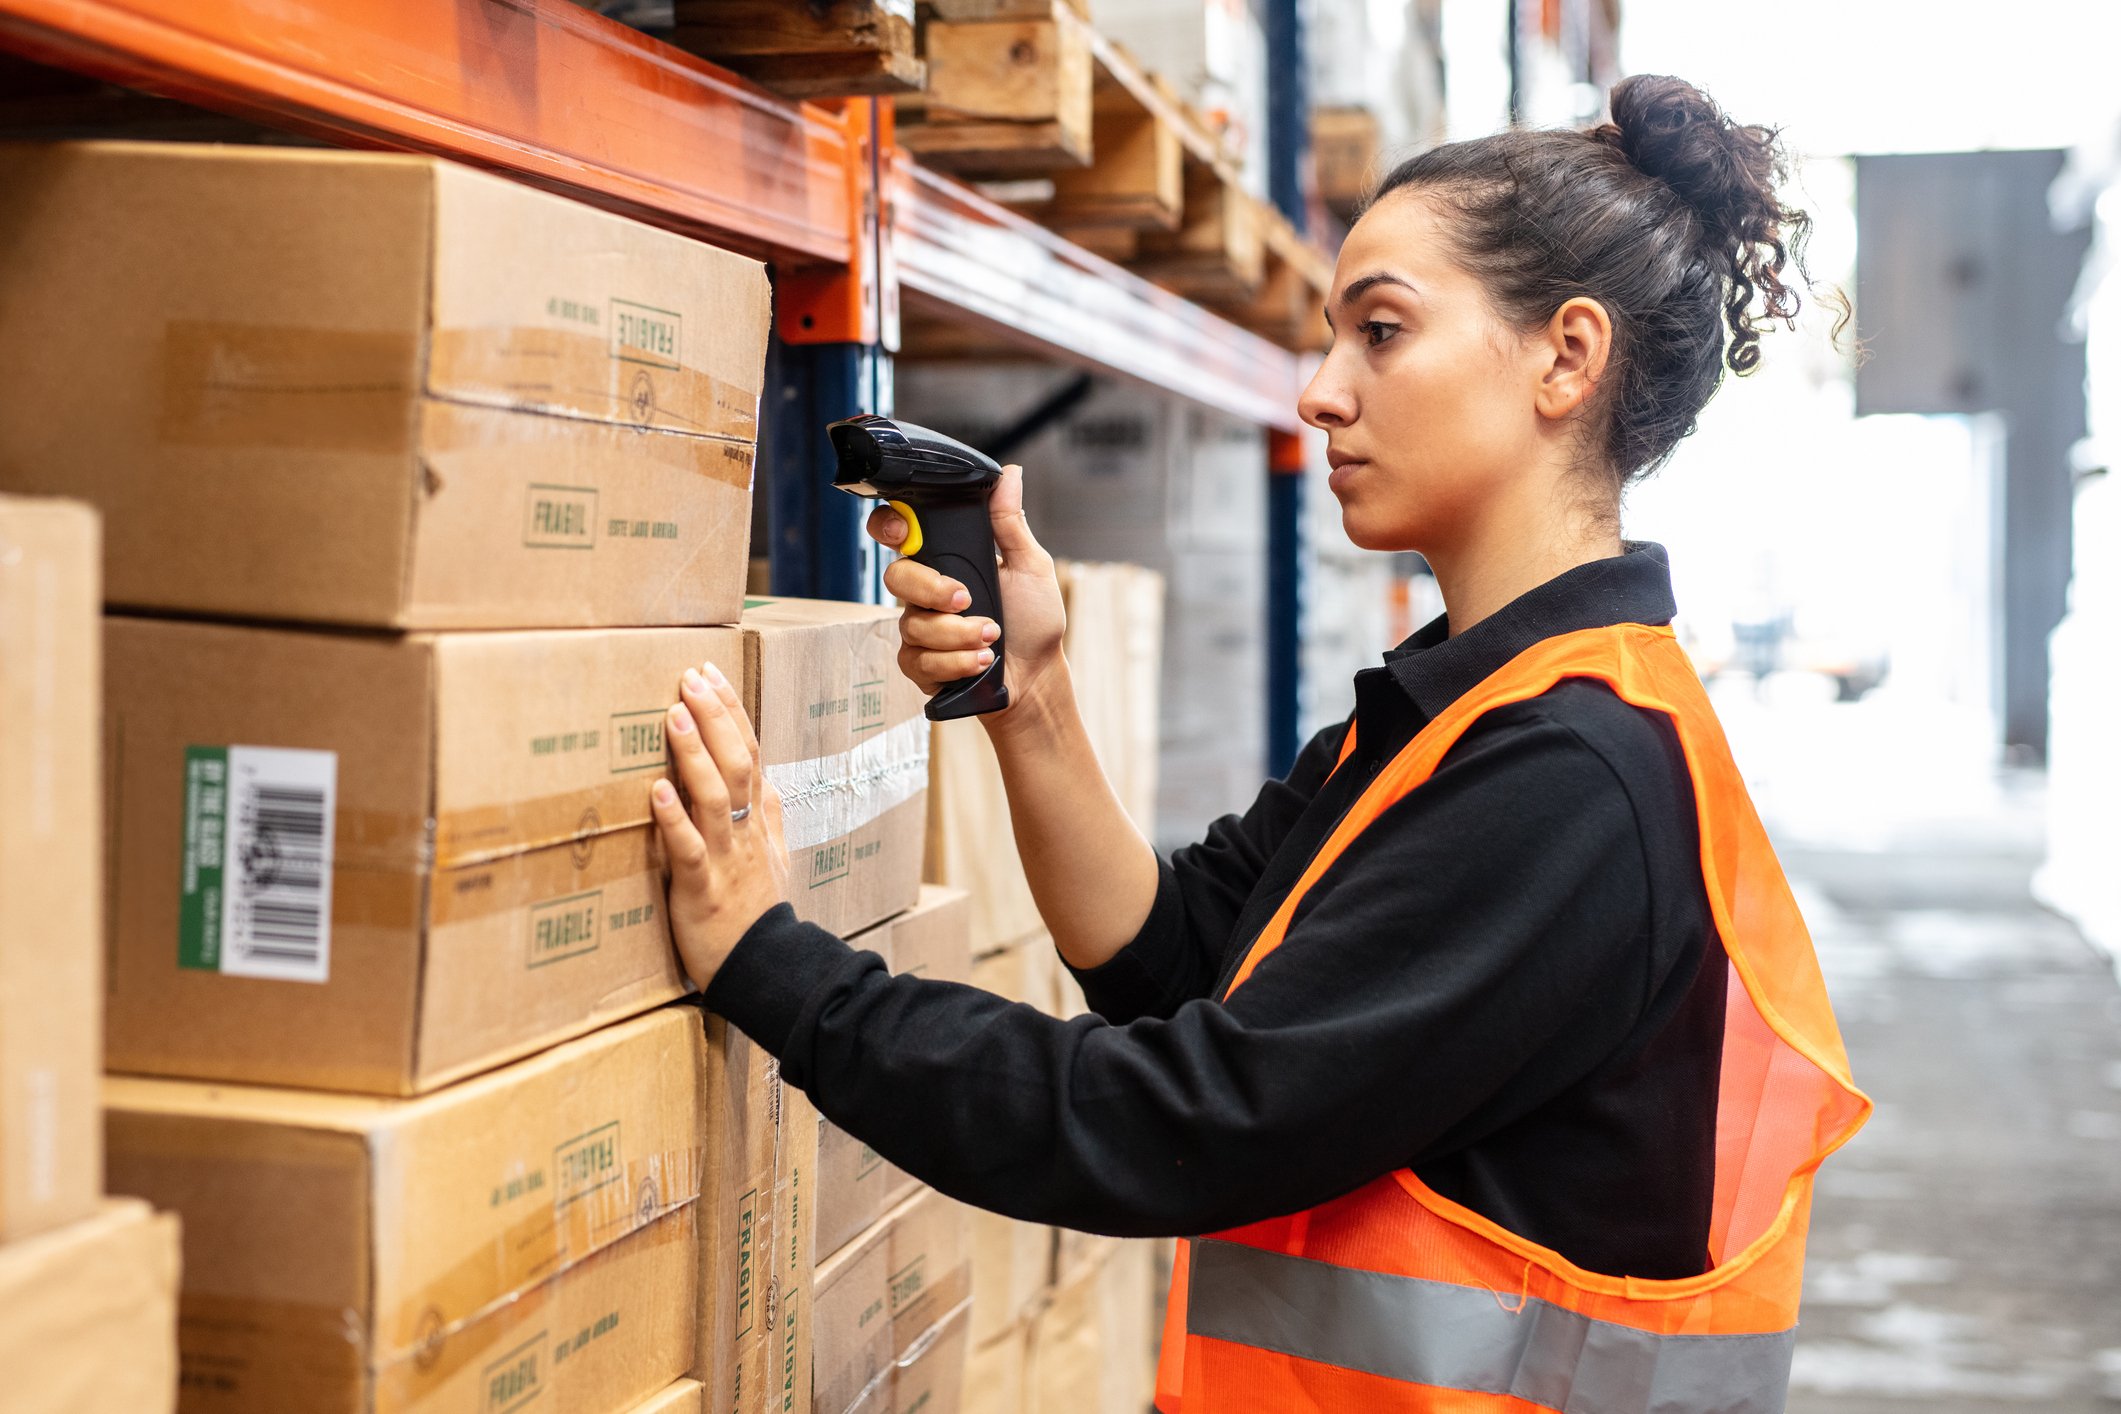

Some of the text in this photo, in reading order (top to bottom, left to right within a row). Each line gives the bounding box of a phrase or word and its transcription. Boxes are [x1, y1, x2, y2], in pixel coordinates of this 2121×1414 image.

[618, 313, 674, 354] FRAGILE
[533, 500, 587, 536] FRAGIL
[619, 722, 662, 757] FRAGIL
[814, 841, 846, 877] FRAGILE
[535, 907, 593, 954] FRAGILE
[793, 1168, 799, 1187] UP
[739, 1210, 752, 1318] FRAGIL
[784, 1309, 795, 1412] RAGILE
